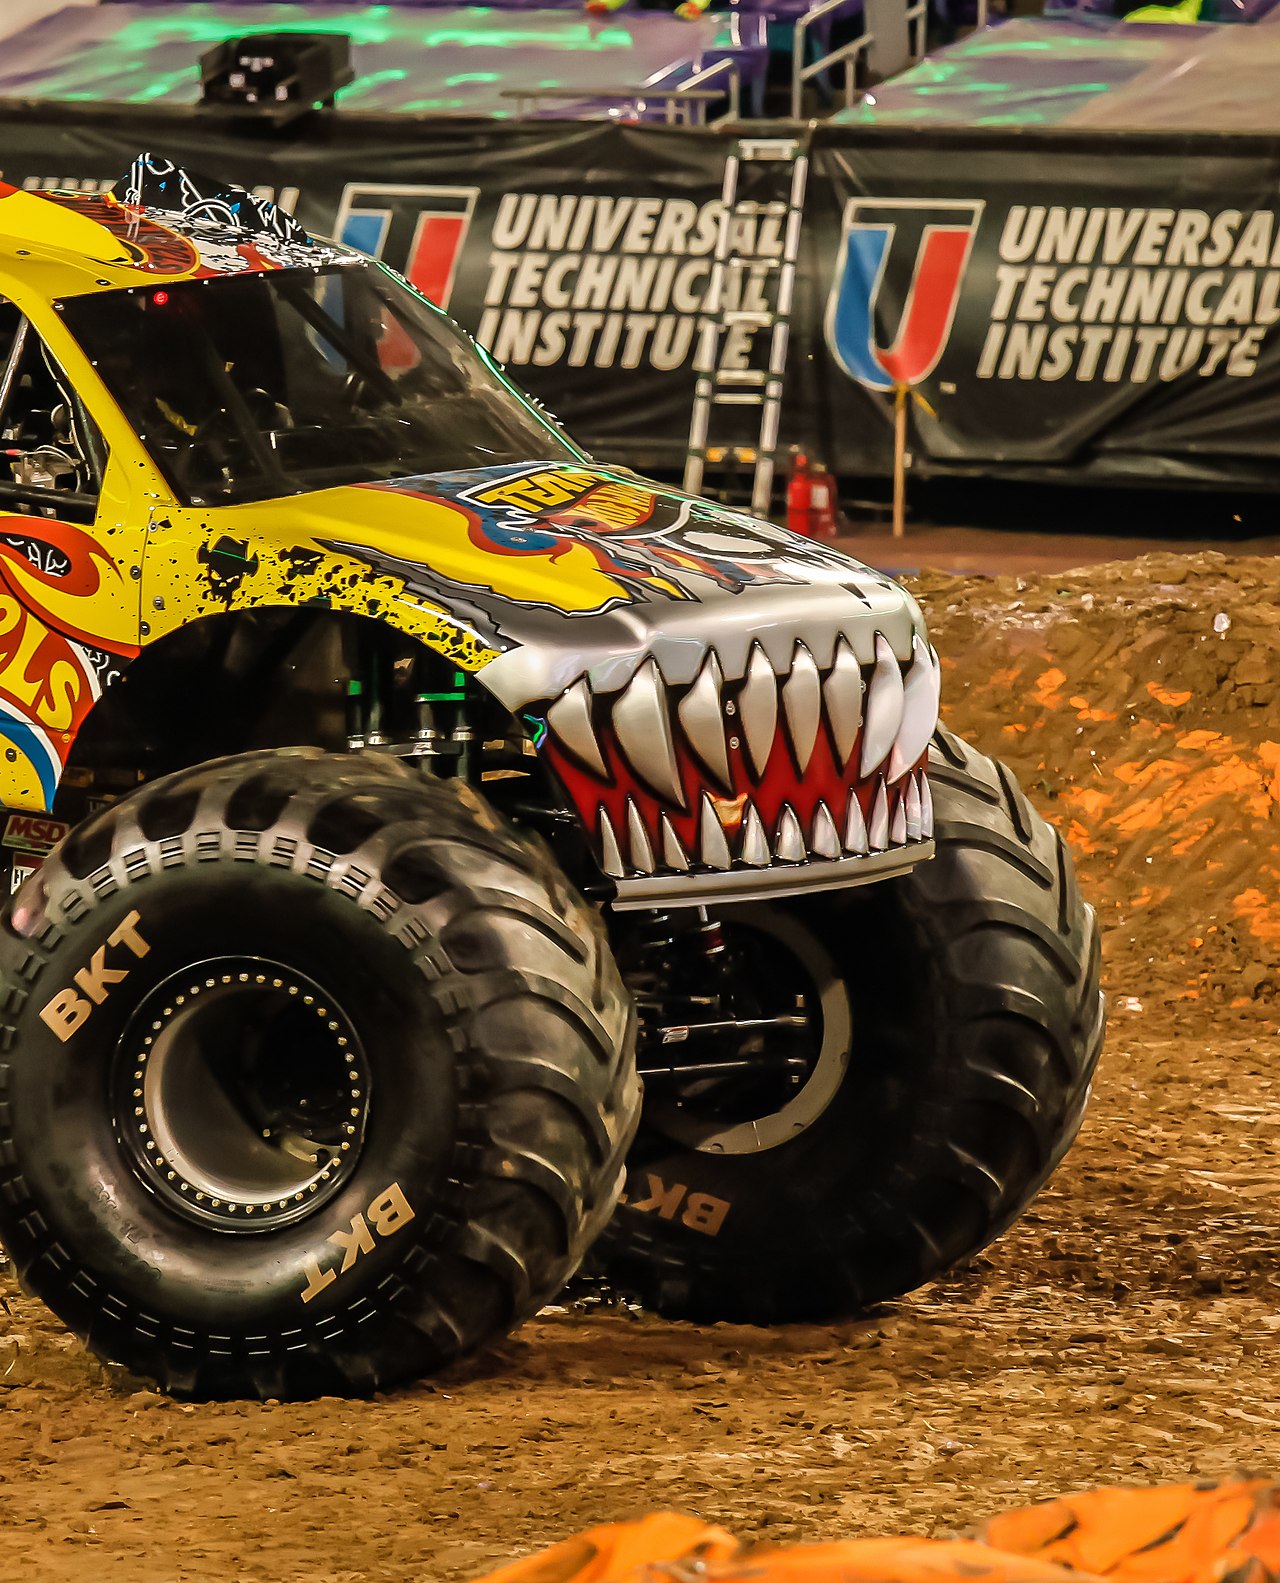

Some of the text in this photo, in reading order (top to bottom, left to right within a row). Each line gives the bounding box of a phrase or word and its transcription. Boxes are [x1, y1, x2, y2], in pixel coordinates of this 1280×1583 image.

[491, 192, 784, 257] UNIVERSAL
[999, 204, 1280, 268] UNIVERSA
[976, 322, 1267, 384] INSTITUTE
[7, 817, 68, 843] MSD
[38, 909, 152, 1043] BKT
[618, 1172, 731, 1237] BK
[300, 1181, 416, 1304] BKT
